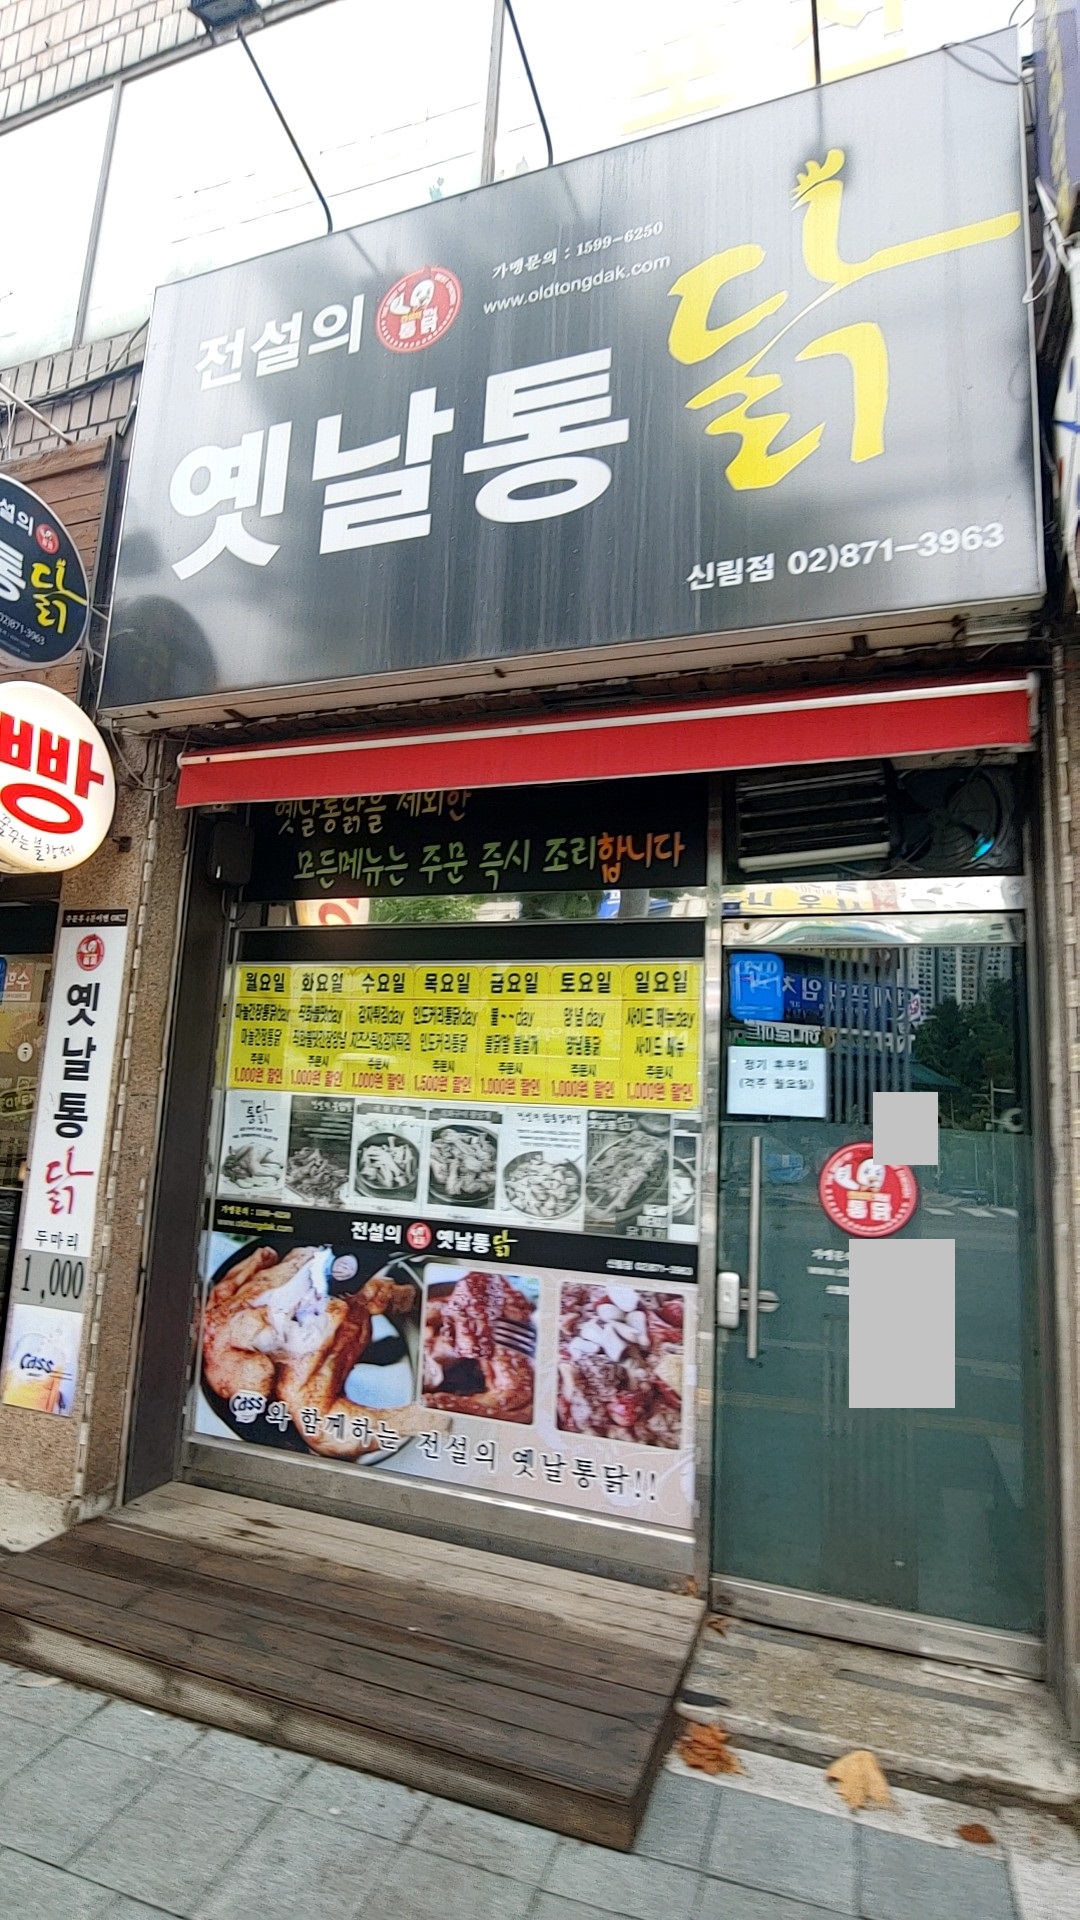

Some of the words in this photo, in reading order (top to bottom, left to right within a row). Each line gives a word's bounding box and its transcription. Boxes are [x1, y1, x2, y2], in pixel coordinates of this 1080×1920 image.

[491, 247, 558, 280] 가맹문의
[575, 220, 664, 258] 1599-6250
[482, 254, 672, 316] www.oldtongdak.com
[193, 293, 366, 391] 전설의
[685, 552, 776, 591] 신림점
[786, 521, 1006, 576] 02)871-3963
[0, 711, 105, 836] 빵
[293, 844, 409, 890] 모든메뉴는
[418, 841, 469, 885] 주문
[478, 838, 531, 892] 즉시
[542, 831, 686, 884] 조리합니다
[245, 972, 286, 993] 월요일
[302, 972, 344, 993] 화요일
[361, 972, 406, 994] 수요일
[424, 972, 470, 994] 목요일
[490, 972, 539, 994] 금요일
[560, 971, 612, 994] 토요일
[634, 970, 688, 994] 일요일
[743, 1058, 768, 1072] 정기
[267, 1068, 284, 1085] 할인
[324, 1070, 344, 1088] 할인
[386, 1073, 407, 1092] 할인
[451, 1076, 475, 1095] 할인
[520, 1078, 542, 1097] 할인
[594, 1080, 617, 1100] 할인
[670, 1082, 694, 1103] 할인
[34, 1230, 79, 1252] 두마리
[350, 1221, 403, 1245] 전설의
[301, 1406, 400, 1450] 함께하는
[417, 1431, 496, 1471] 전설의
[511, 1448, 658, 1501] 옛날통닭!!
